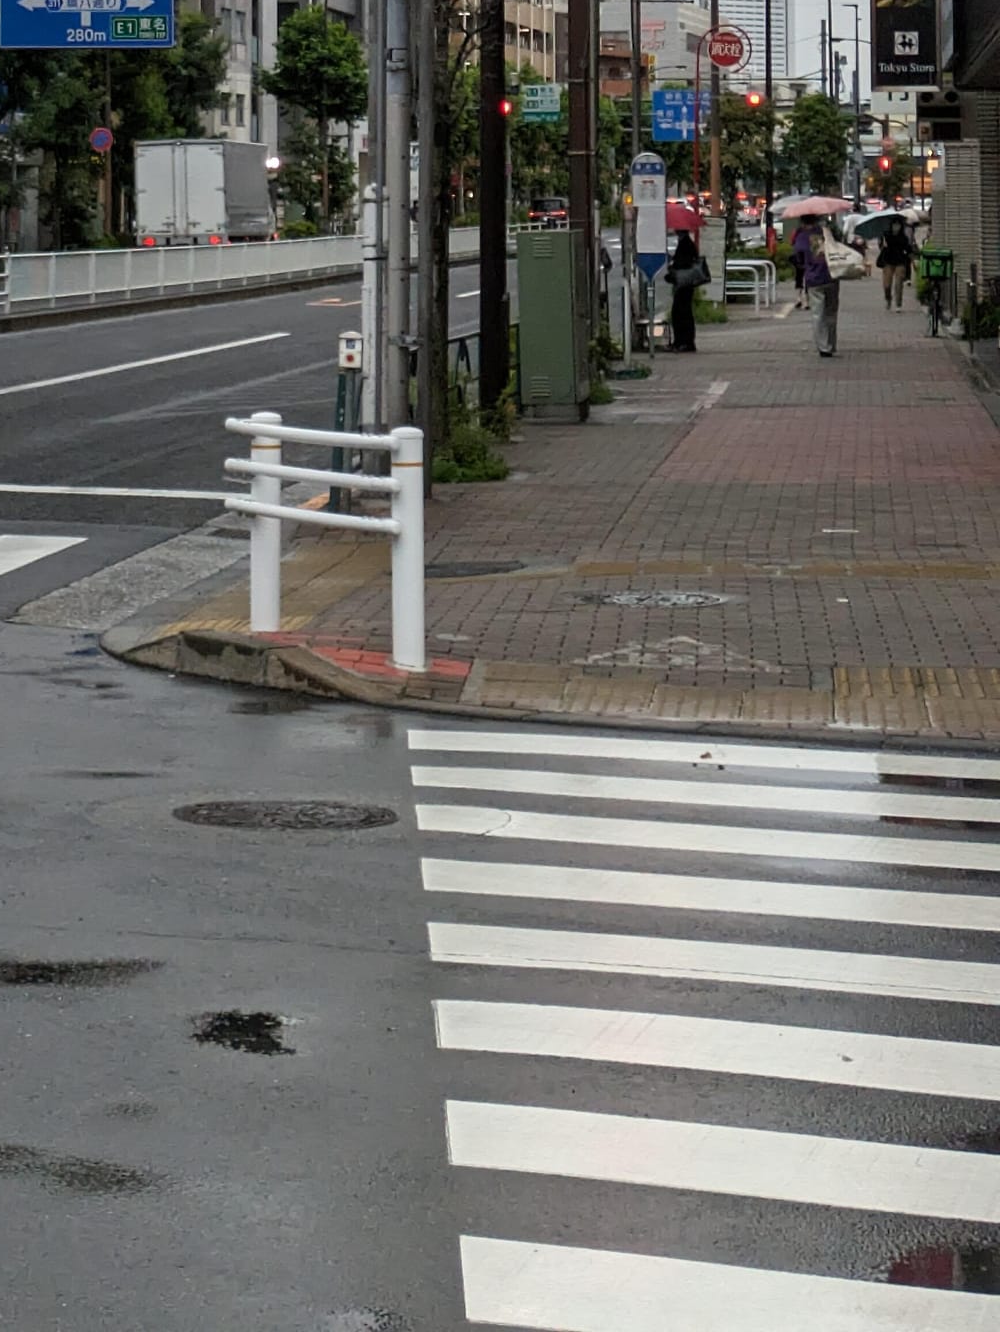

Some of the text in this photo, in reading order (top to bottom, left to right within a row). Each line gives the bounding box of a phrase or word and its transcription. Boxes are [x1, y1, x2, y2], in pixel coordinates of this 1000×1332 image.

[66, 28, 106, 42] 280m
[117, 22, 133, 35] E1
[879, 62, 936, 74] Tokyu Store
